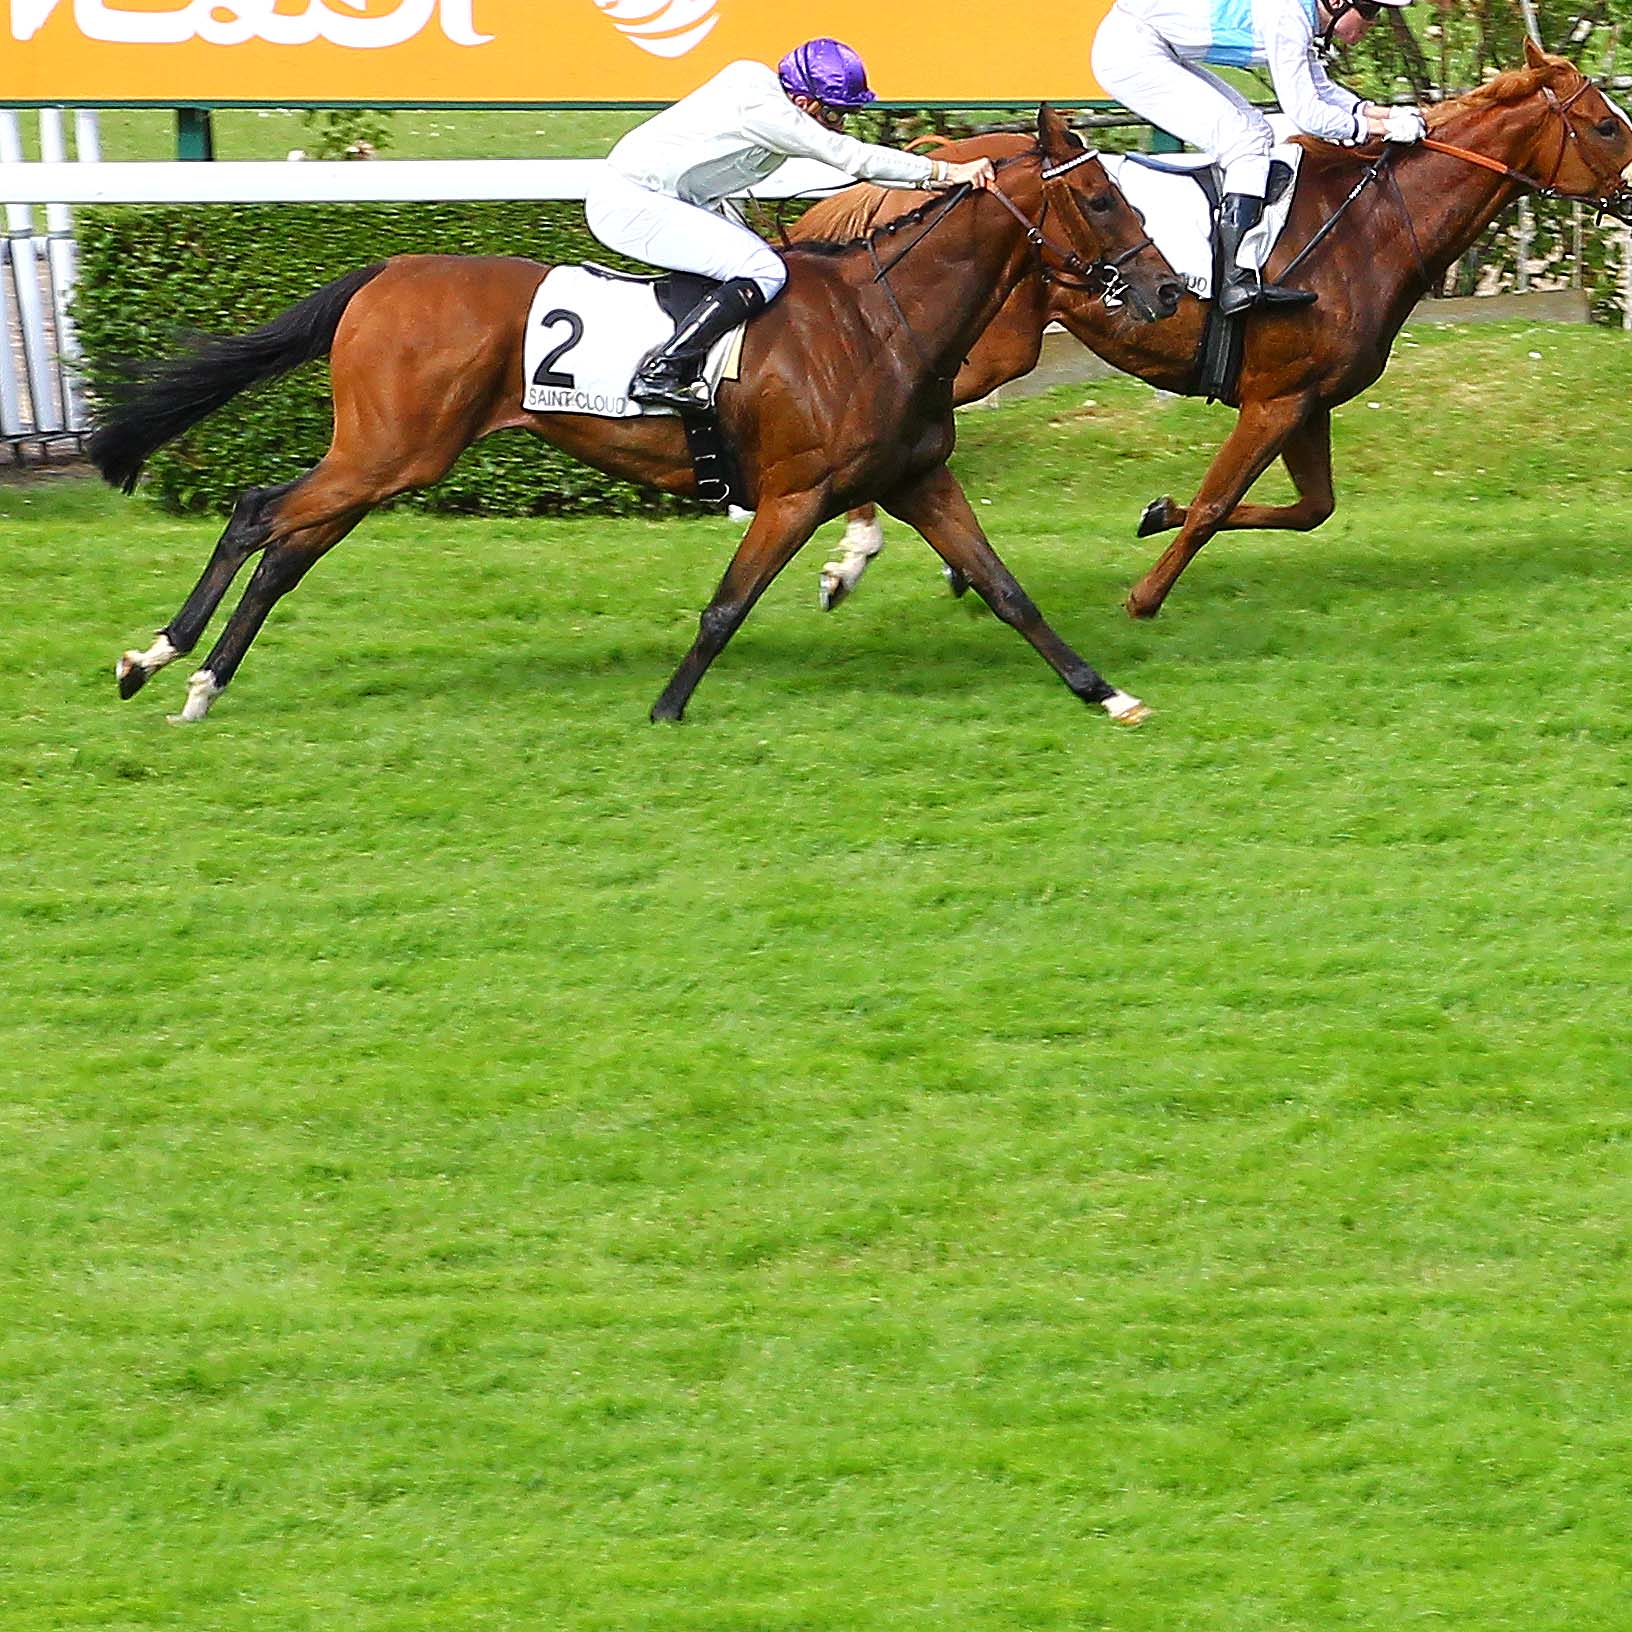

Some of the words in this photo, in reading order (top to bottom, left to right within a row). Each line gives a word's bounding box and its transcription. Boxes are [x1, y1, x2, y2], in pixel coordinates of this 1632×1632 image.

[532, 308, 584, 389] 2
[529, 388, 574, 406] SAINT
[575, 391, 627, 415] CLOUD
